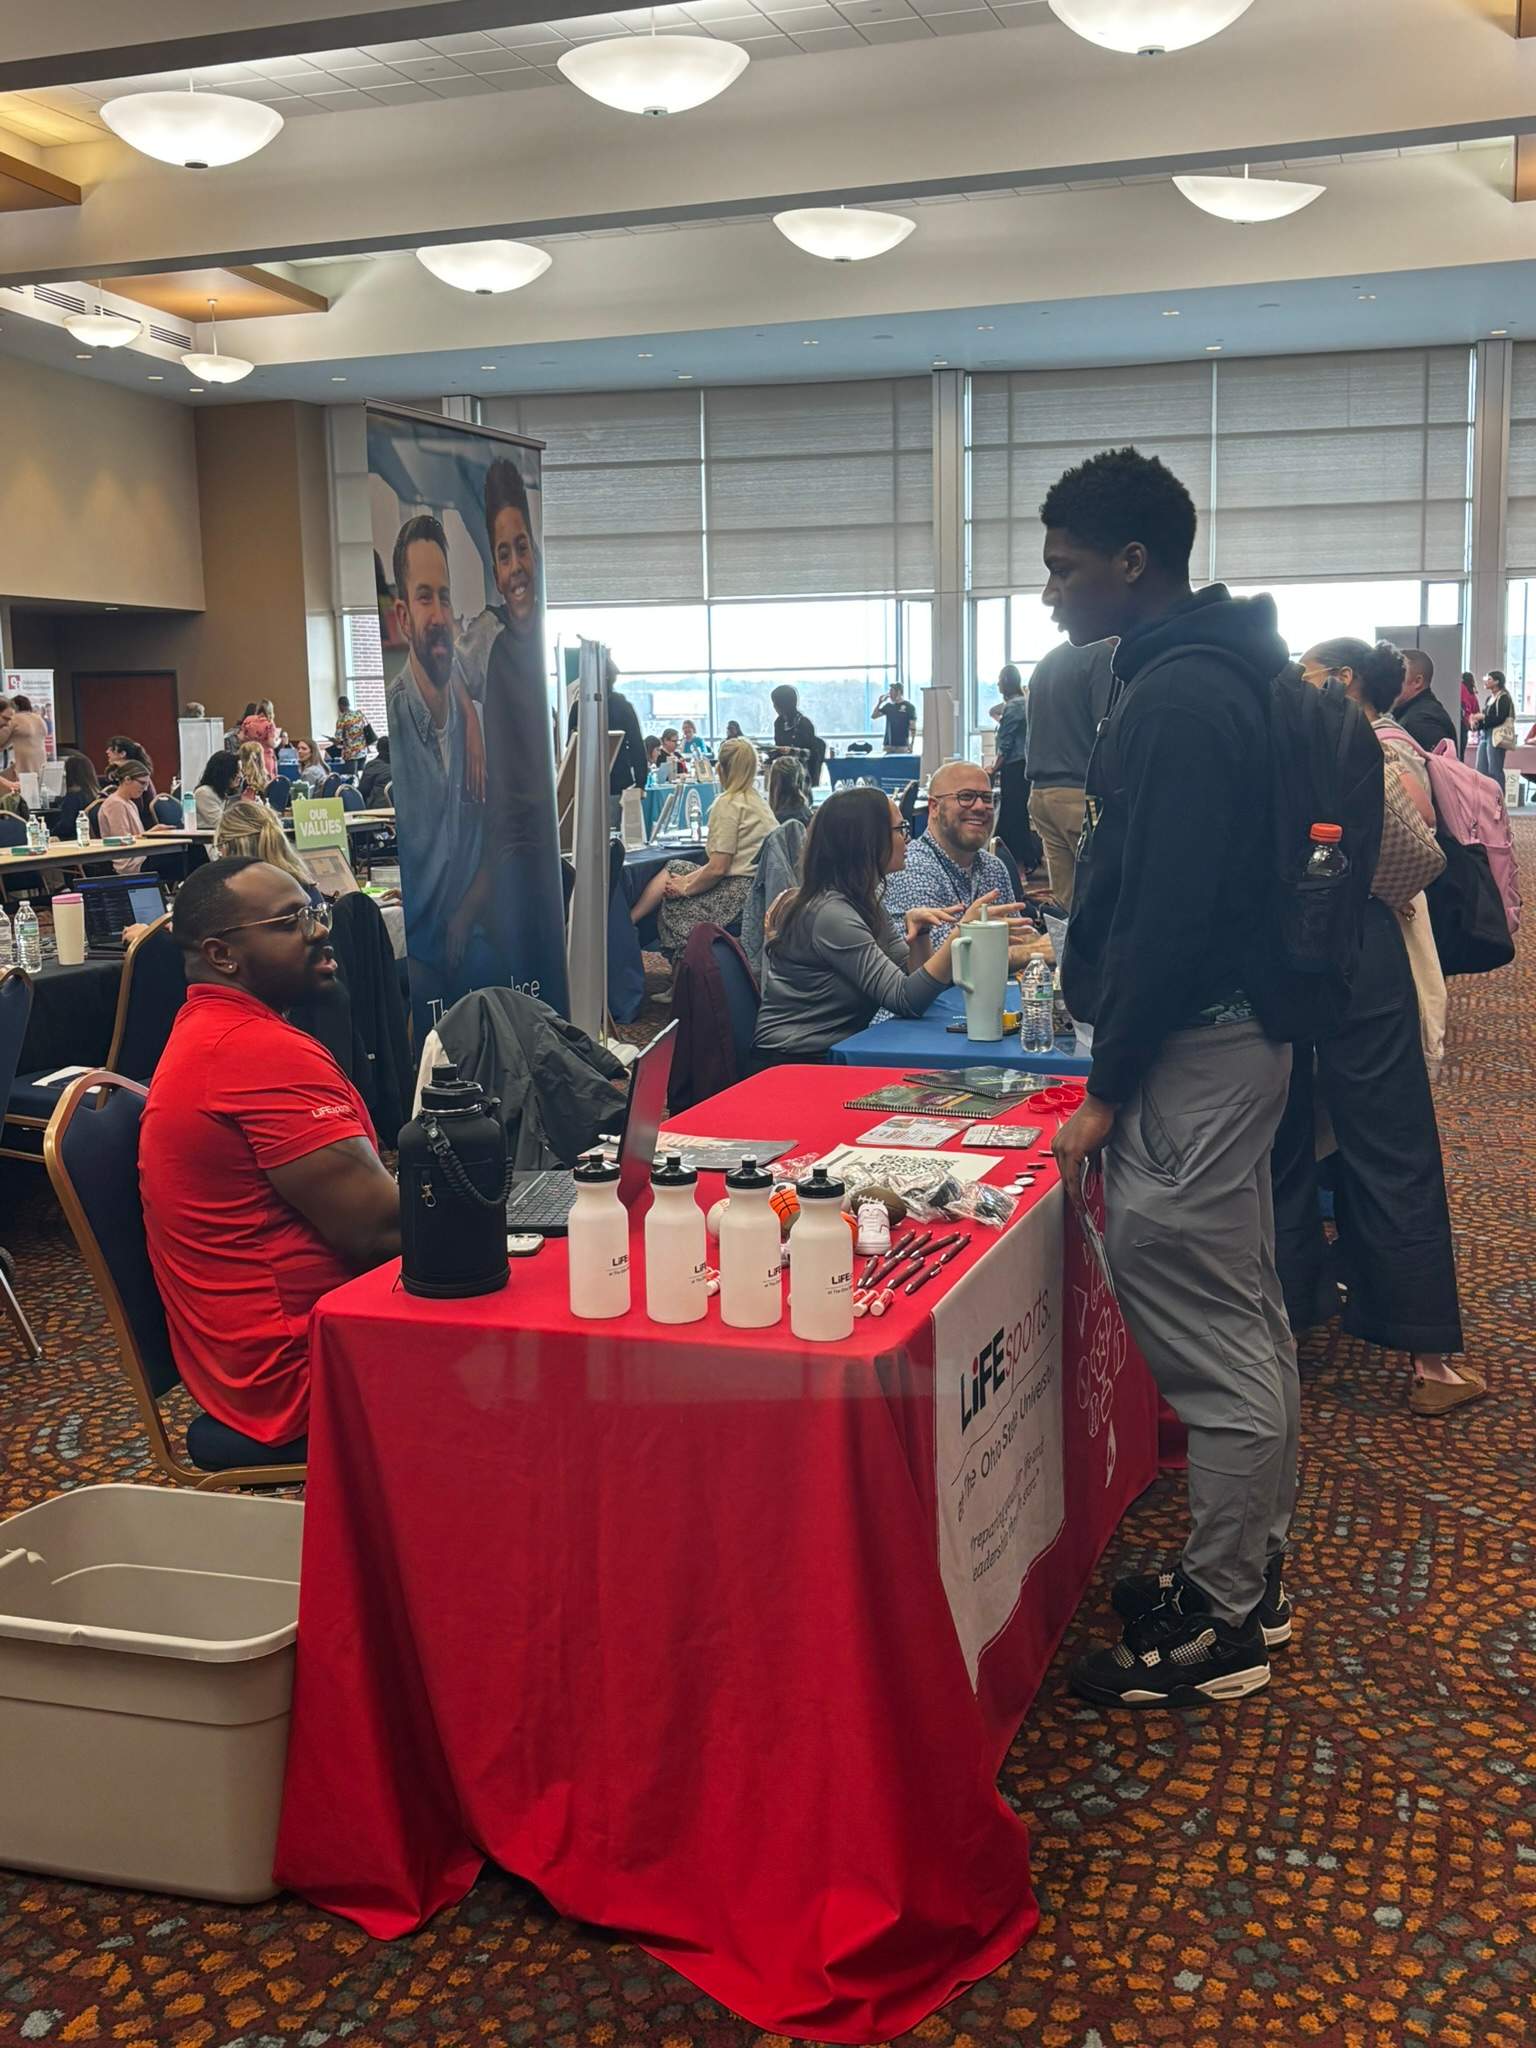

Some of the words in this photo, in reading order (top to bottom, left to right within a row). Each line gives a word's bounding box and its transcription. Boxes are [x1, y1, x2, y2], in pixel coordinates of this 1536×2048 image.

[310, 808, 328, 820] OUR
[300, 819, 342, 837] VALUES
[981, 1440, 1002, 1478] Ohio
